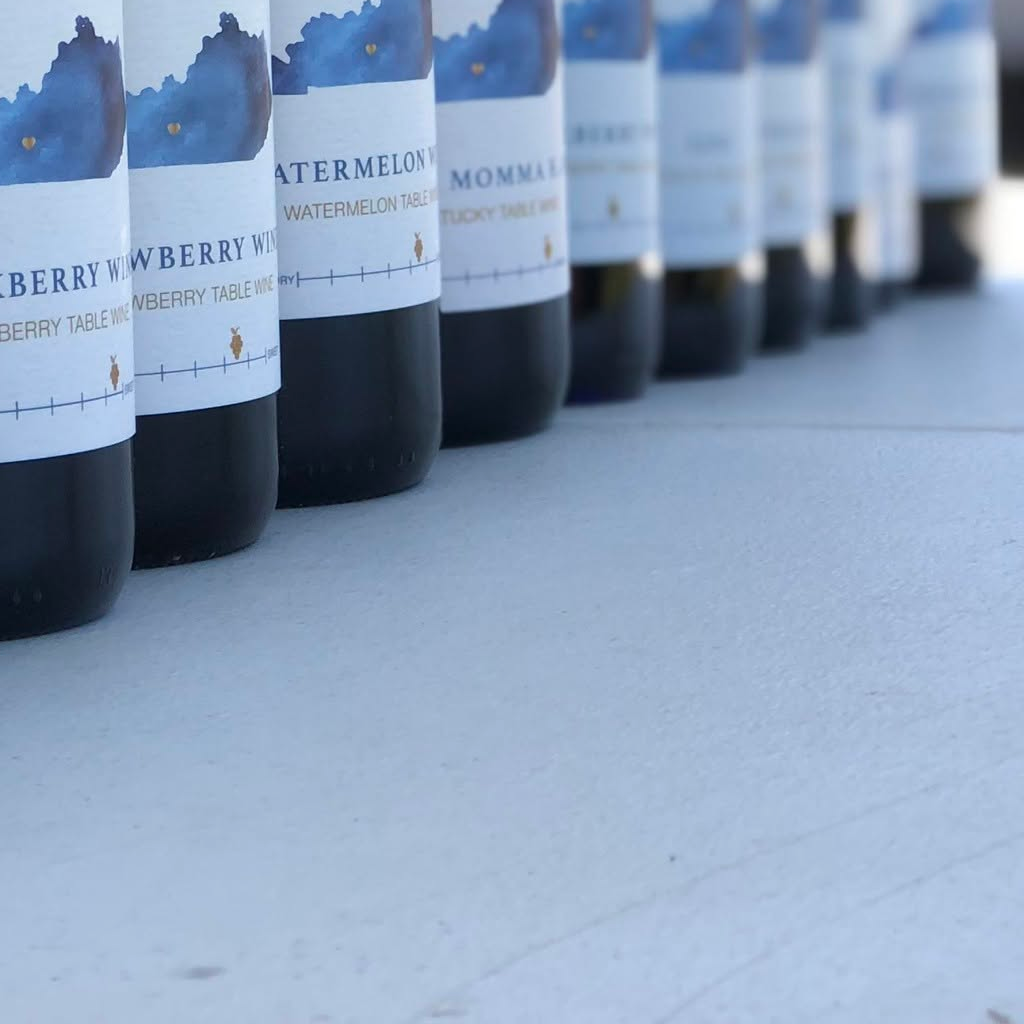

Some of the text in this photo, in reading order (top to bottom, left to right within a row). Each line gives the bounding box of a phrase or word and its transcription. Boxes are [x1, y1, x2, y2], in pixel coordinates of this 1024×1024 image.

[274, 148, 425, 184] ATERMELON
[283, 195, 397, 221] WATERMELON
[400, 189, 429, 209] TABLE
[251, 228, 276, 256] WIN
[211, 280, 252, 304] TABLE
[66, 310, 108, 334] TABLE
